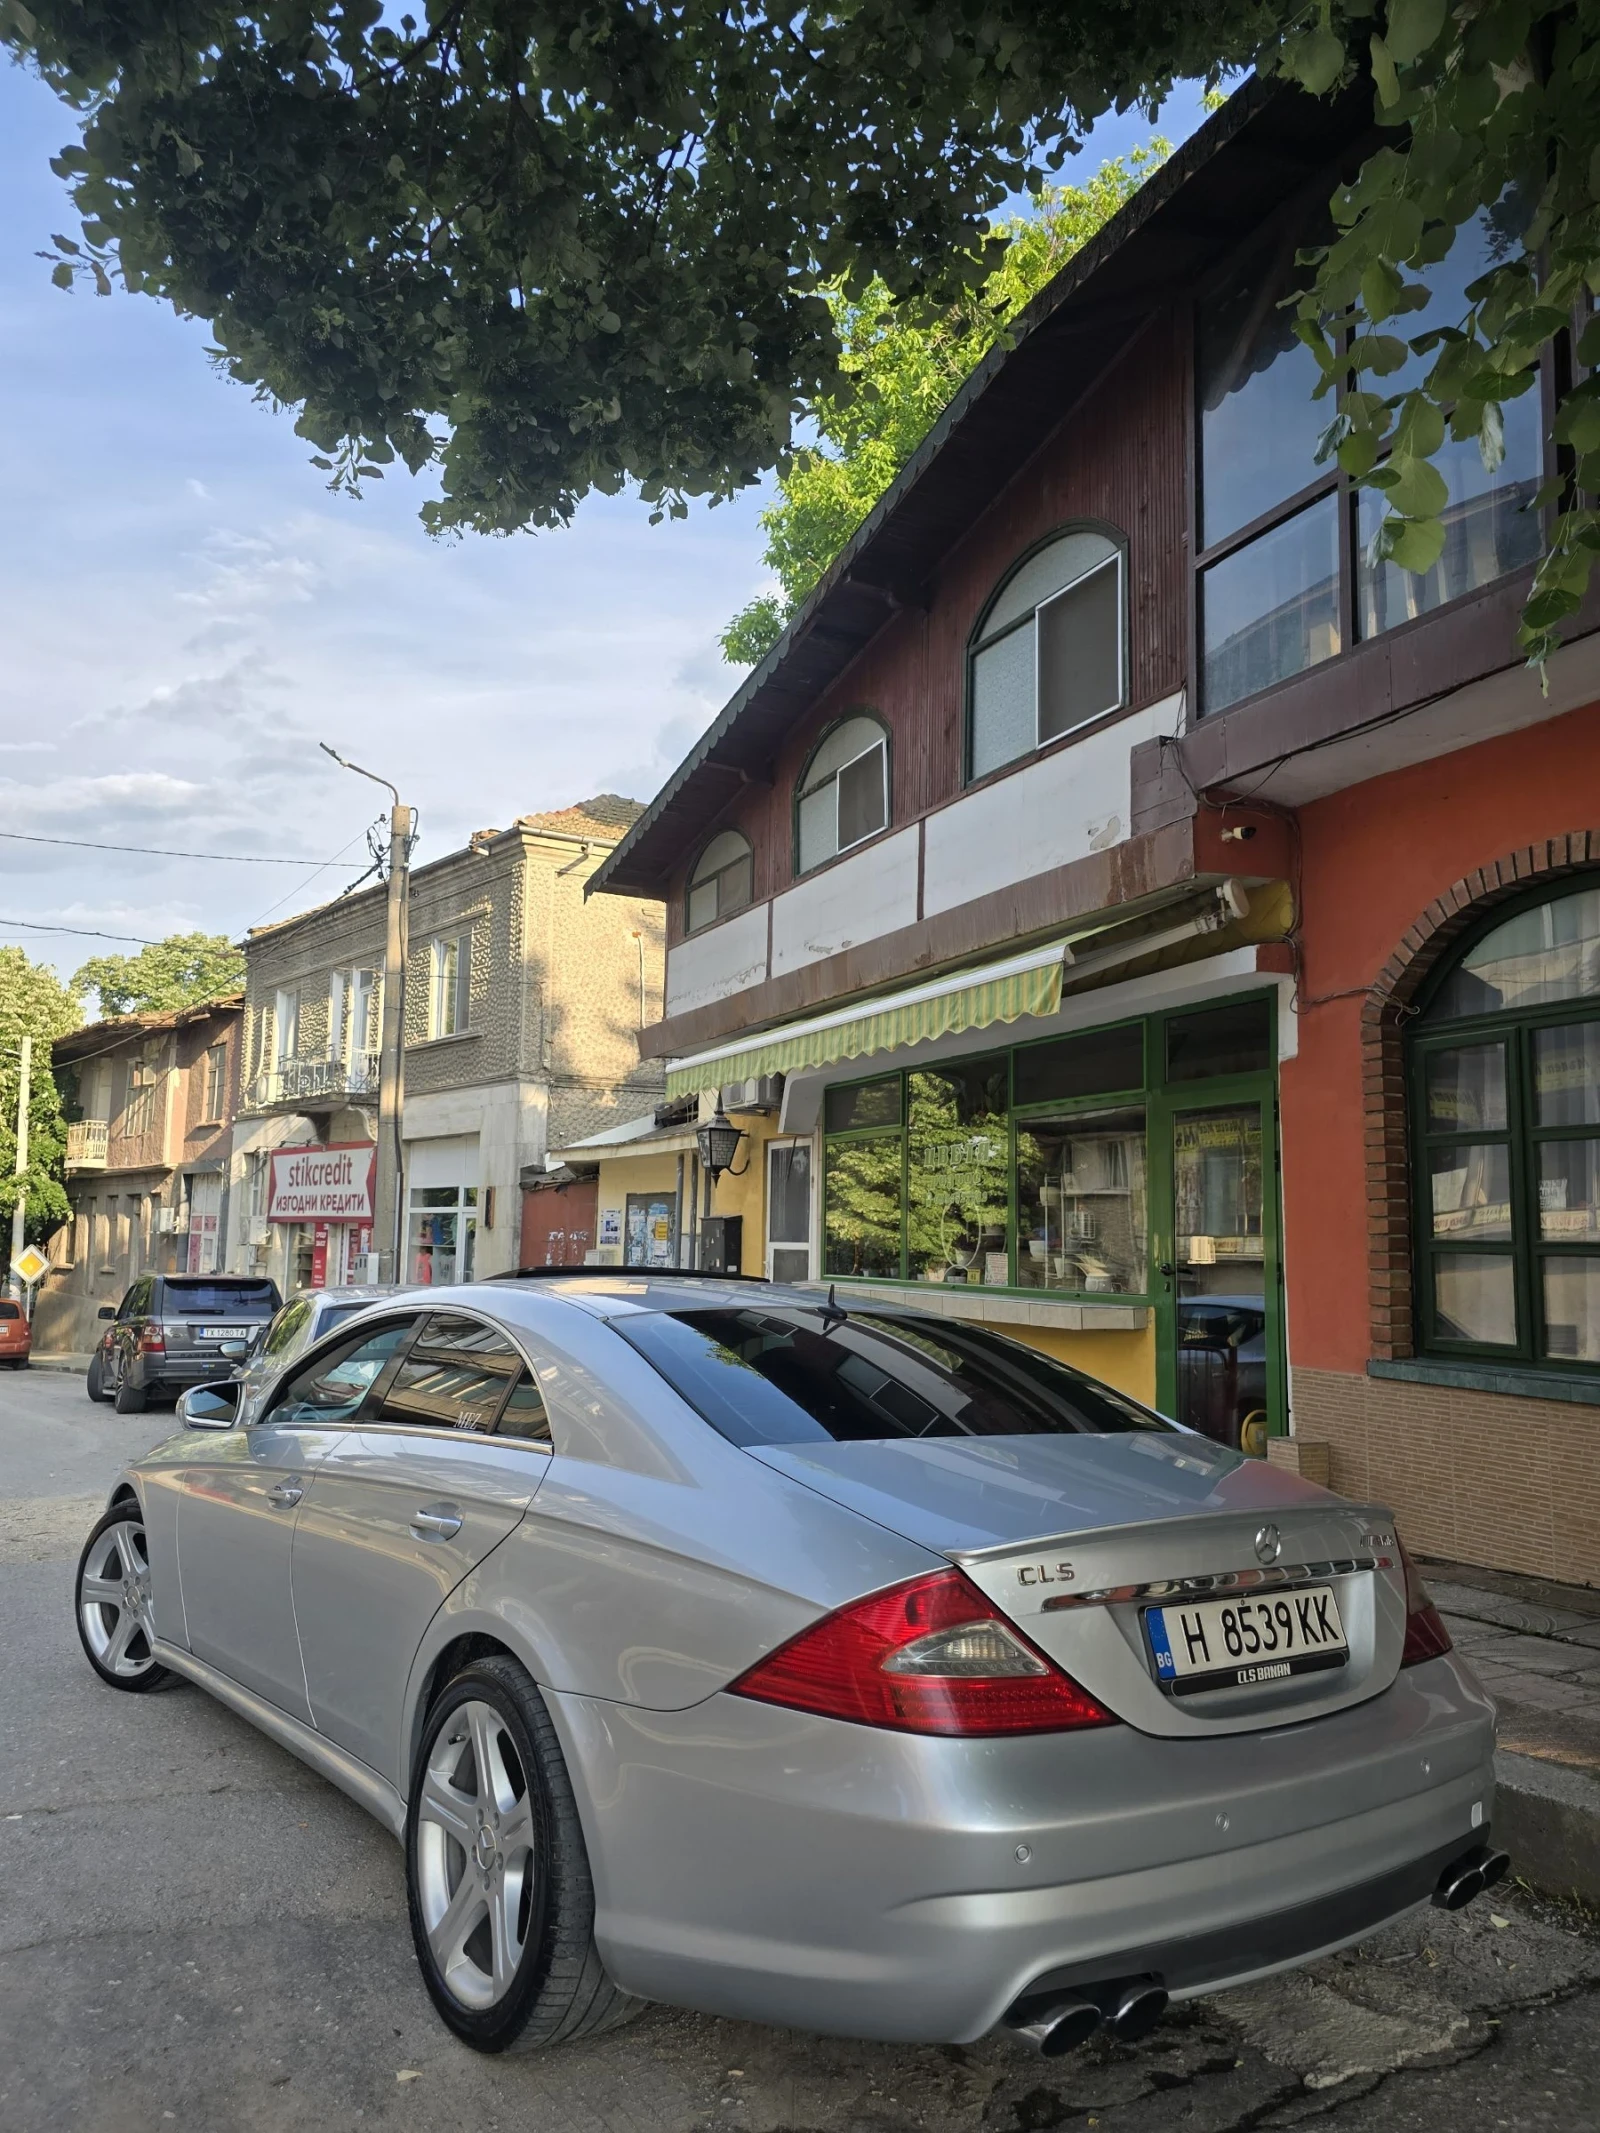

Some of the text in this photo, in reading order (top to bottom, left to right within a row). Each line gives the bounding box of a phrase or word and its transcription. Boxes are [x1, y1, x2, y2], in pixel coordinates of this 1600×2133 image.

[288, 1153, 353, 1187] stikcredit
[276, 1193, 365, 1213] ИЗГОДНИ КРЕДИТИ
[205, 1329, 245, 1337] TX 1280 TA
[1017, 1562, 1075, 1587] CLS
[1179, 1612, 1211, 1665] H
[1155, 1652, 1172, 1668] BG
[1237, 1662, 1292, 1684] CLS BANAN
